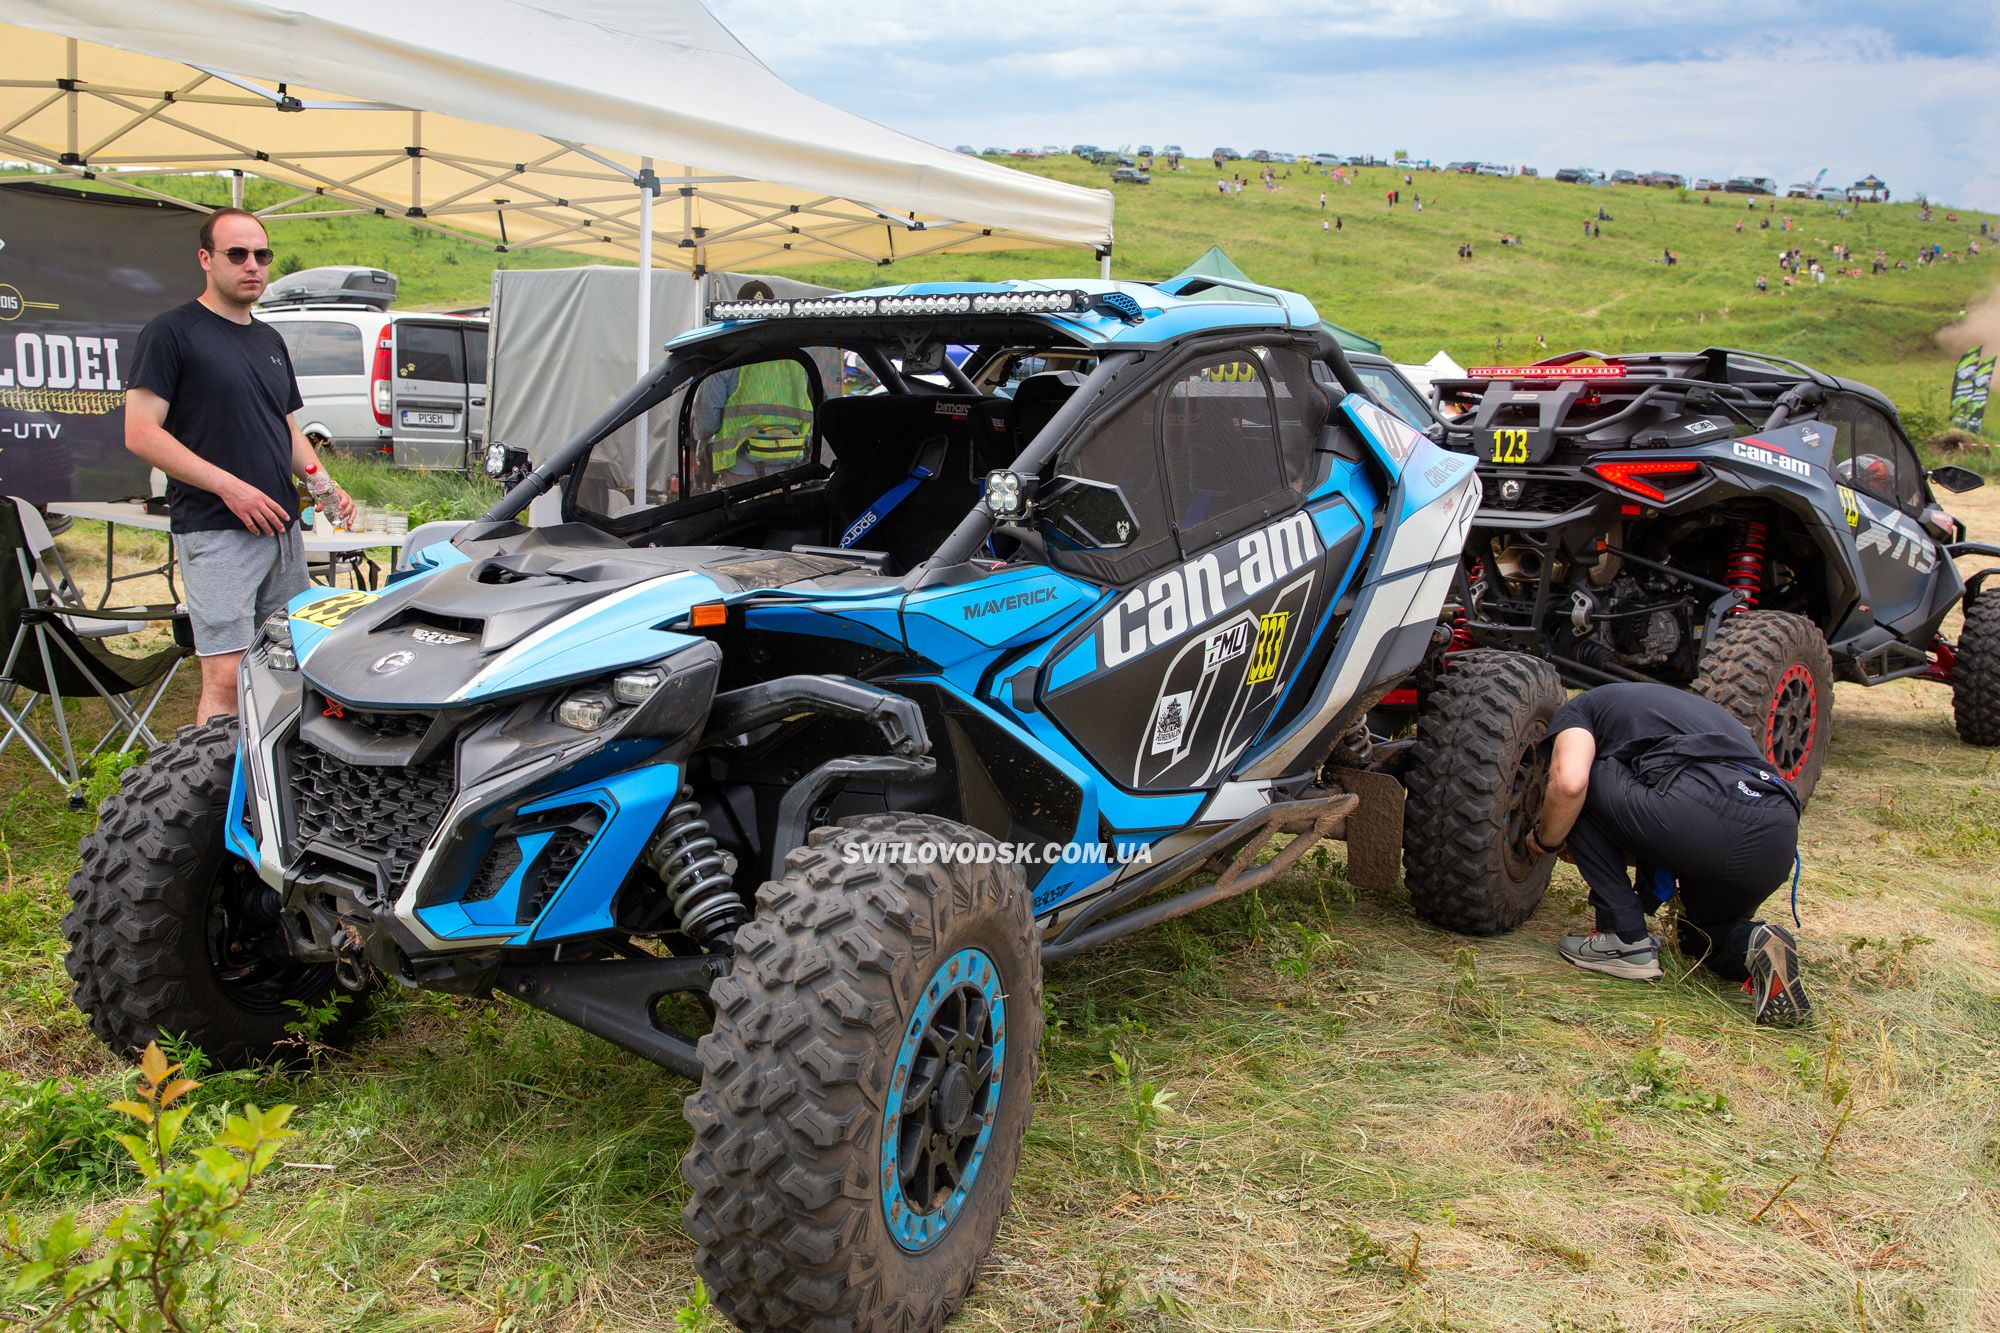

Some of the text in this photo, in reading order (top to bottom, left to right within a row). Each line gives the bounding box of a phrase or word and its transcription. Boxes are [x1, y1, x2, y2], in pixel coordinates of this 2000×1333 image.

[0, 295, 18, 309] 015
[1492, 428, 1528, 464] 123
[1733, 442, 1811, 477] can-am
[963, 586, 1058, 620] MAVERICK
[1103, 511, 1318, 668] can-am
[1249, 615, 1286, 681] 333
